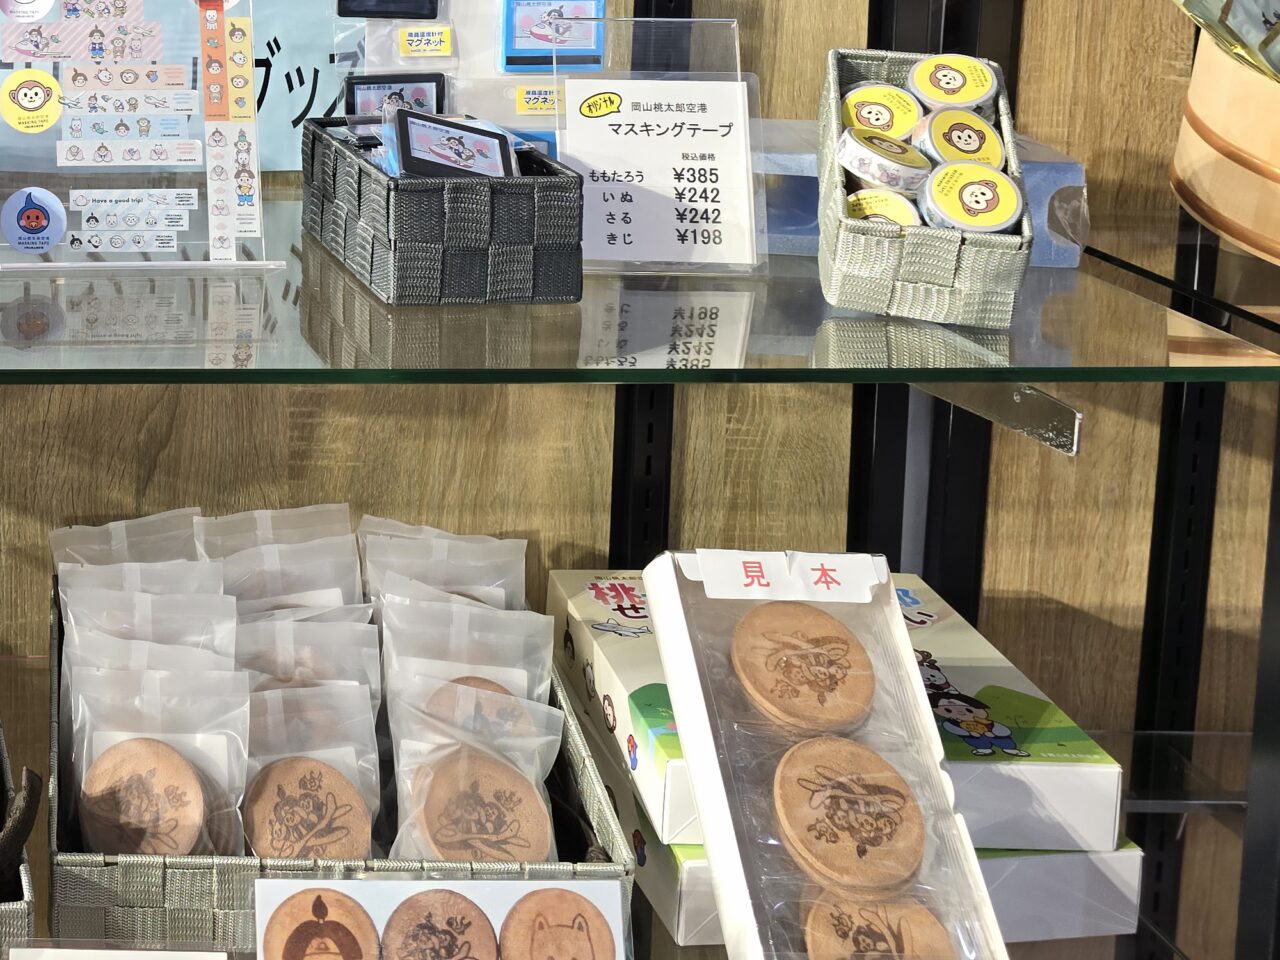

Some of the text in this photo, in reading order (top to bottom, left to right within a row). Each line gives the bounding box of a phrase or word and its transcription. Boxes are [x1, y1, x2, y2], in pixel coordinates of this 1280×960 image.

[406, 37, 445, 47] マグネット
[631, 101, 708, 114] 岡山桃太郎空港
[608, 122, 734, 138] マスキングテープ
[681, 152, 716, 162] 税込価格
[588, 168, 719, 184] ももたろう ¥385
[674, 187, 721, 204] ¥242
[675, 207, 722, 225] ¥242
[675, 228, 723, 246] ¥198
